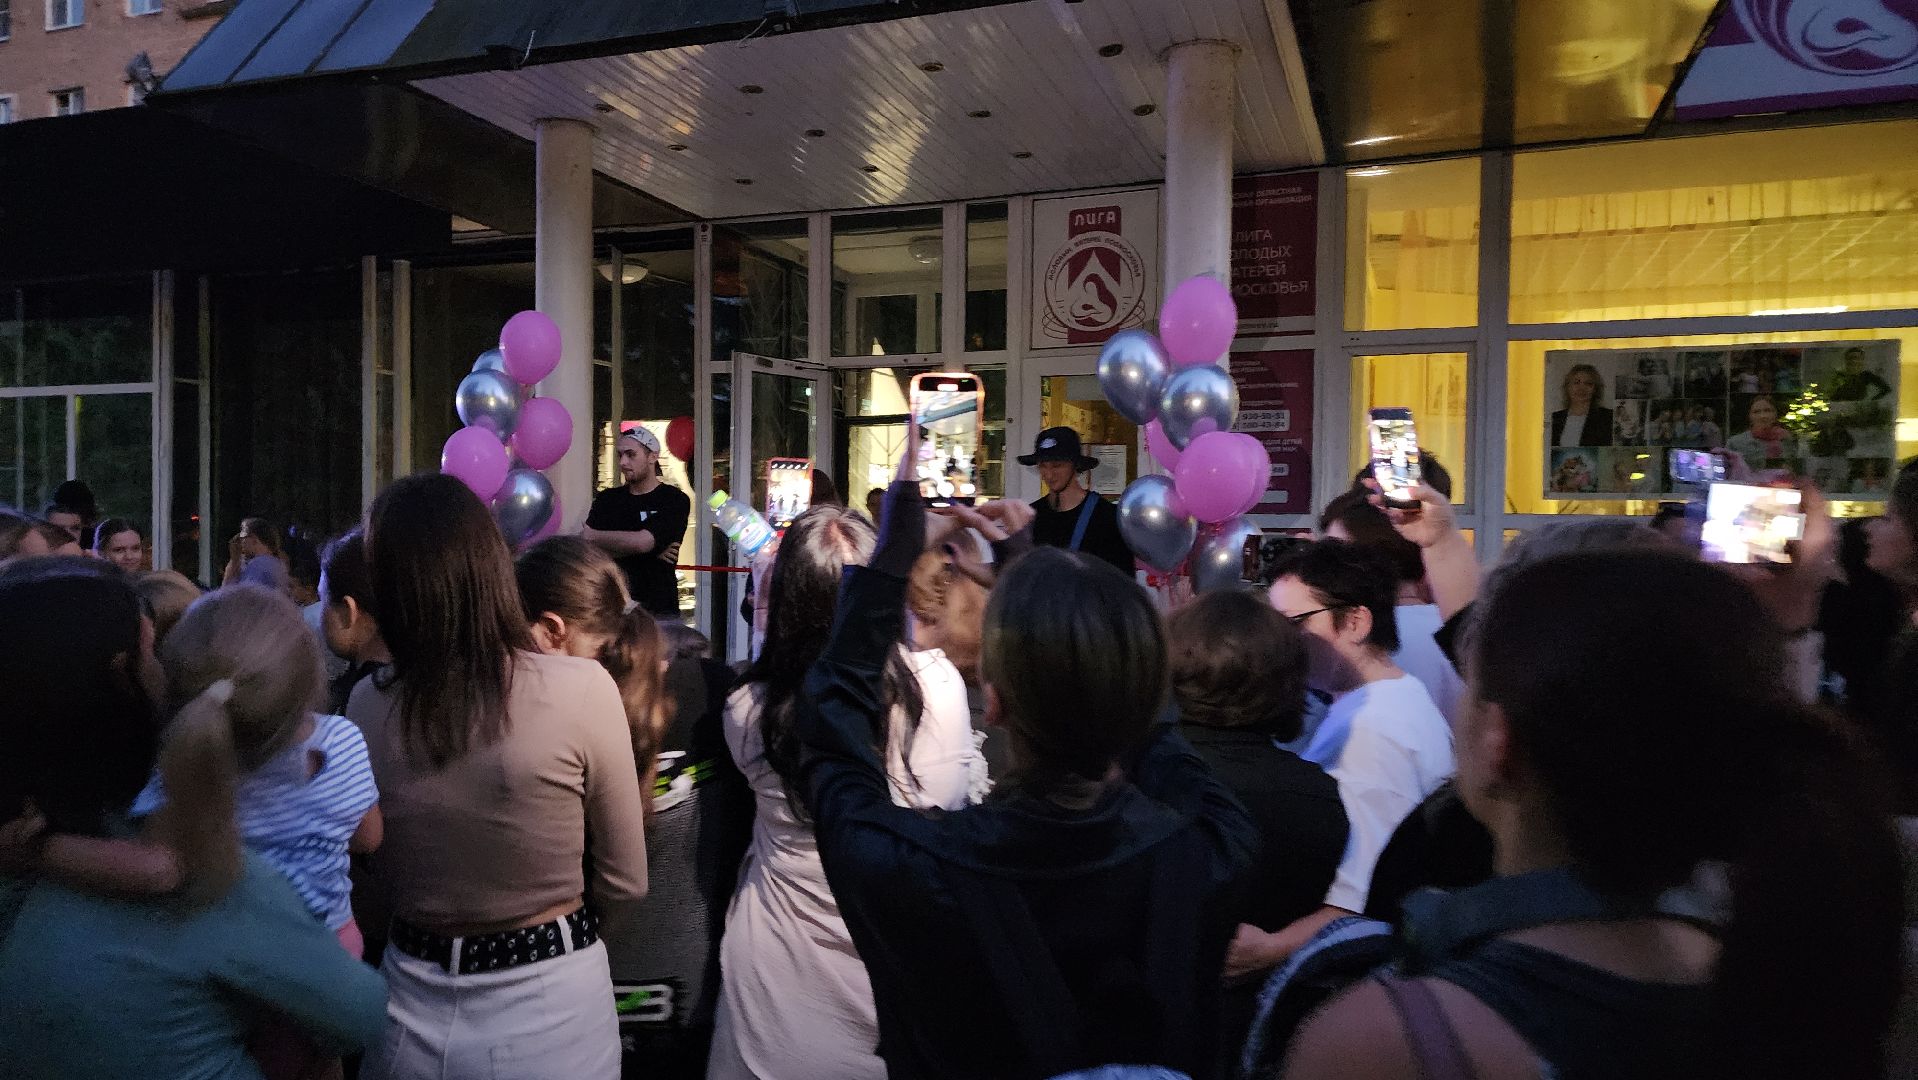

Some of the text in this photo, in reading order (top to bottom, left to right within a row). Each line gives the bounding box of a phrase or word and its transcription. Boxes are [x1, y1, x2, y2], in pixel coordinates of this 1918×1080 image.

[1236, 229, 1272, 242] ЛИГА
[1231, 246, 1292, 260] ОЛОДЫХ
[1232, 260, 1286, 277] АТЕРЕЙ
